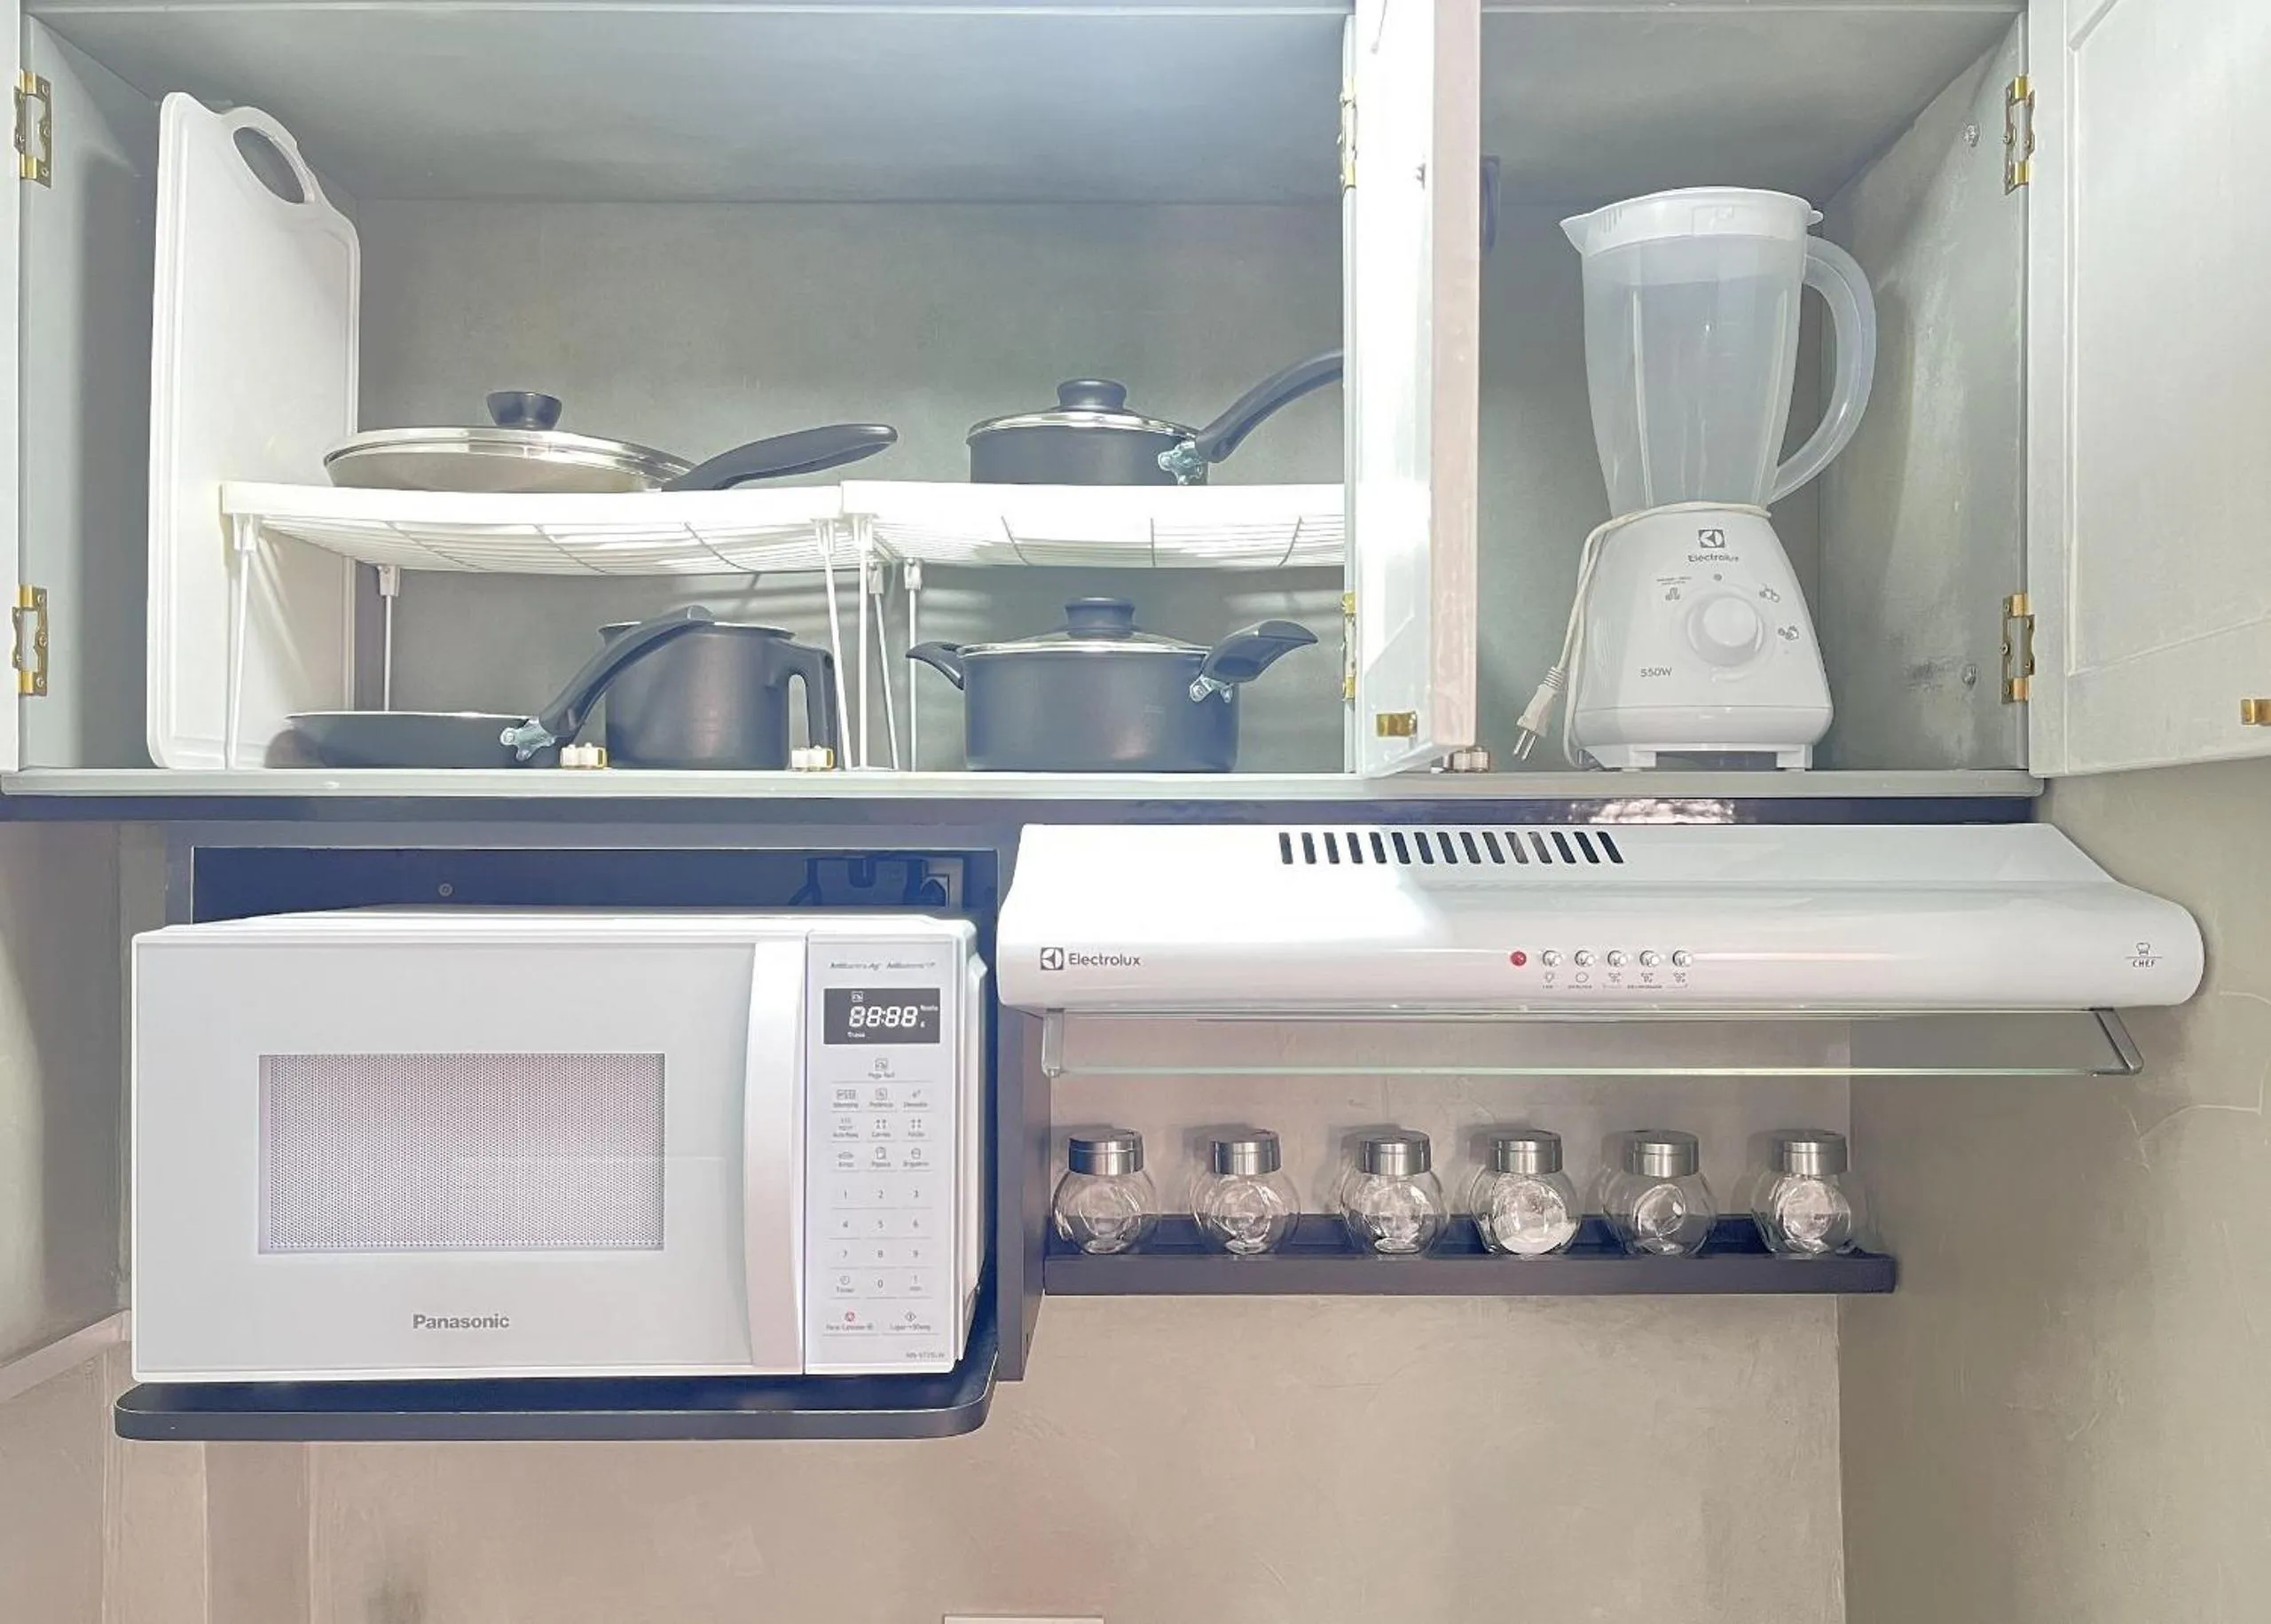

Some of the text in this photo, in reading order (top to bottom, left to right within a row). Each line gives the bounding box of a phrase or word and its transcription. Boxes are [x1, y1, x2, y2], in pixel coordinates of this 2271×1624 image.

[1688, 553, 1739, 563] Electrolux
[1641, 667, 1672, 677] 550W
[1068, 953, 1141, 966] Electrolux
[2133, 959, 2155, 968] CHEF
[413, 1314, 510, 1329] Panasonic
